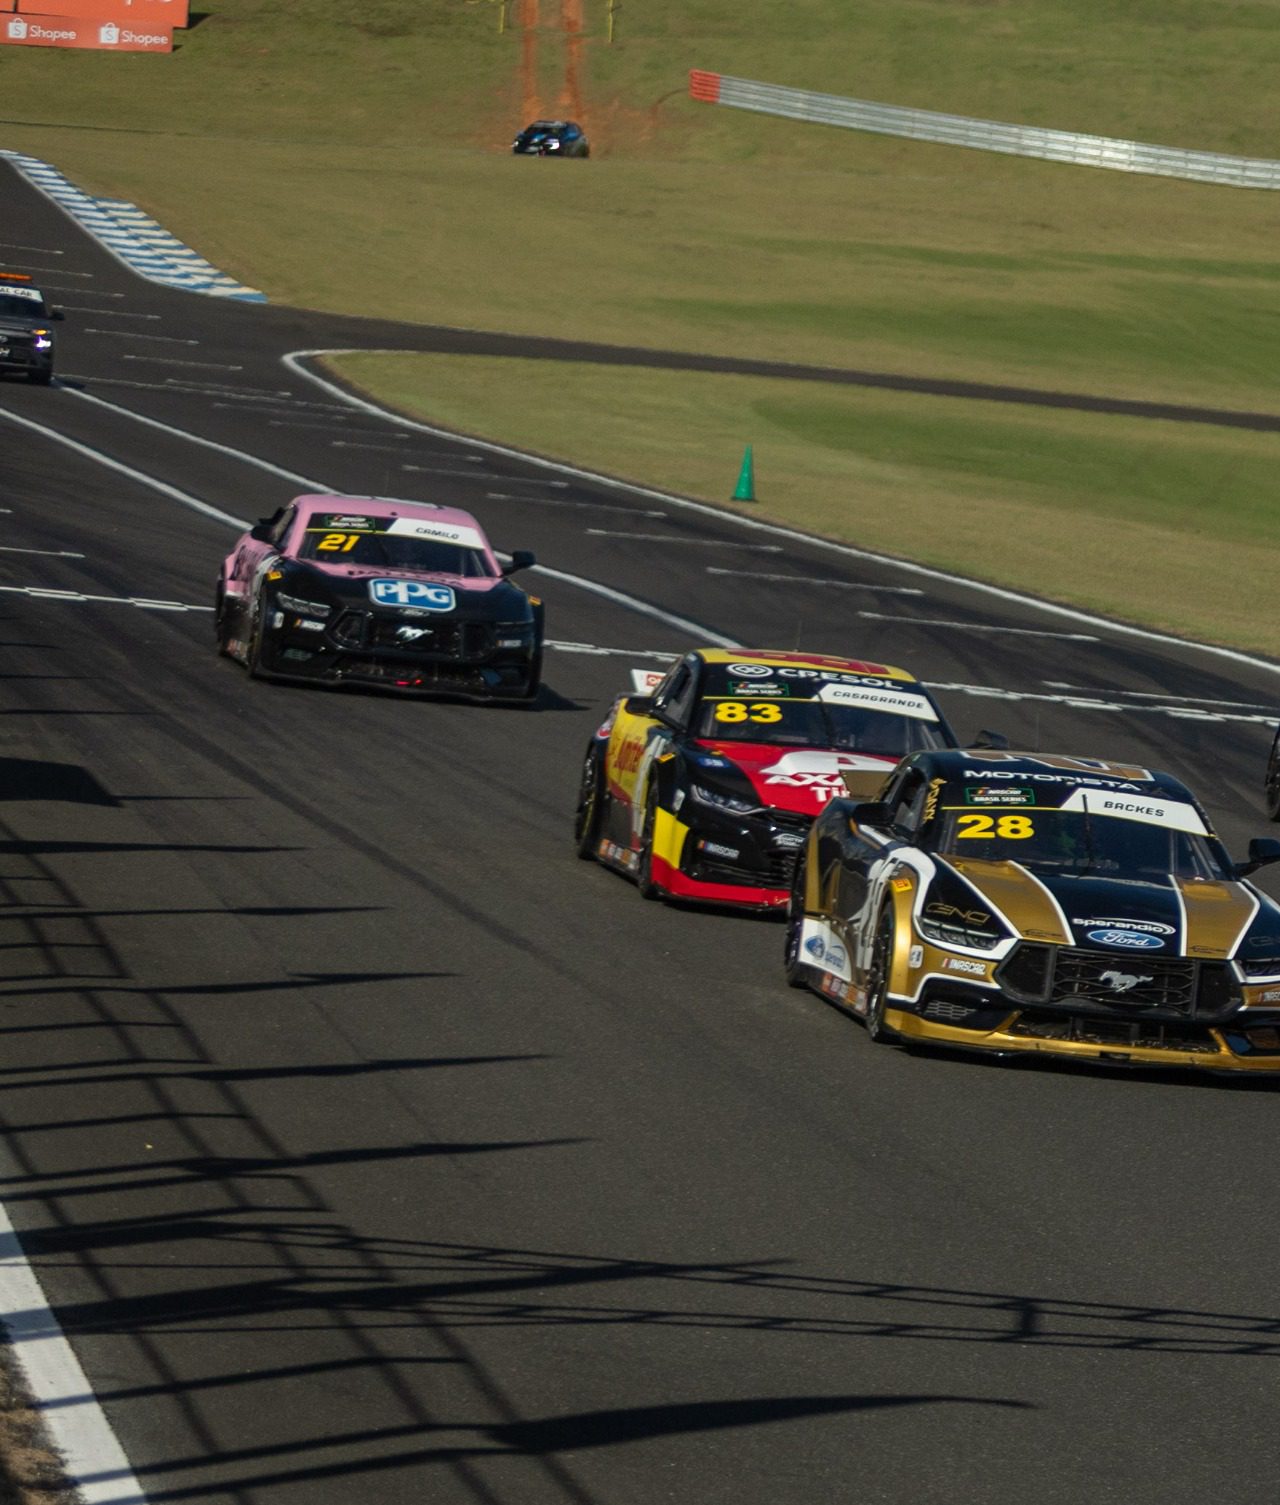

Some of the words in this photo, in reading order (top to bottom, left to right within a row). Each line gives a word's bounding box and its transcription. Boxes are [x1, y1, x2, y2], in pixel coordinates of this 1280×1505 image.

[29, 25, 77, 41] Shopee
[121, 31, 169, 46] Shopee
[316, 533, 361, 553] 21
[415, 527, 460, 540] CAMILO
[375, 581, 450, 604] PPG
[777, 668, 904, 690] CRESOL
[832, 690, 925, 710] CASAGRANDE
[715, 702, 783, 724] 83
[964, 769, 1142, 791] MOTORISTA
[1103, 800, 1166, 817] BACKES
[957, 814, 1035, 840] 28
[1071, 916, 1165, 934] sperandio
[1103, 929, 1150, 948] Ford
